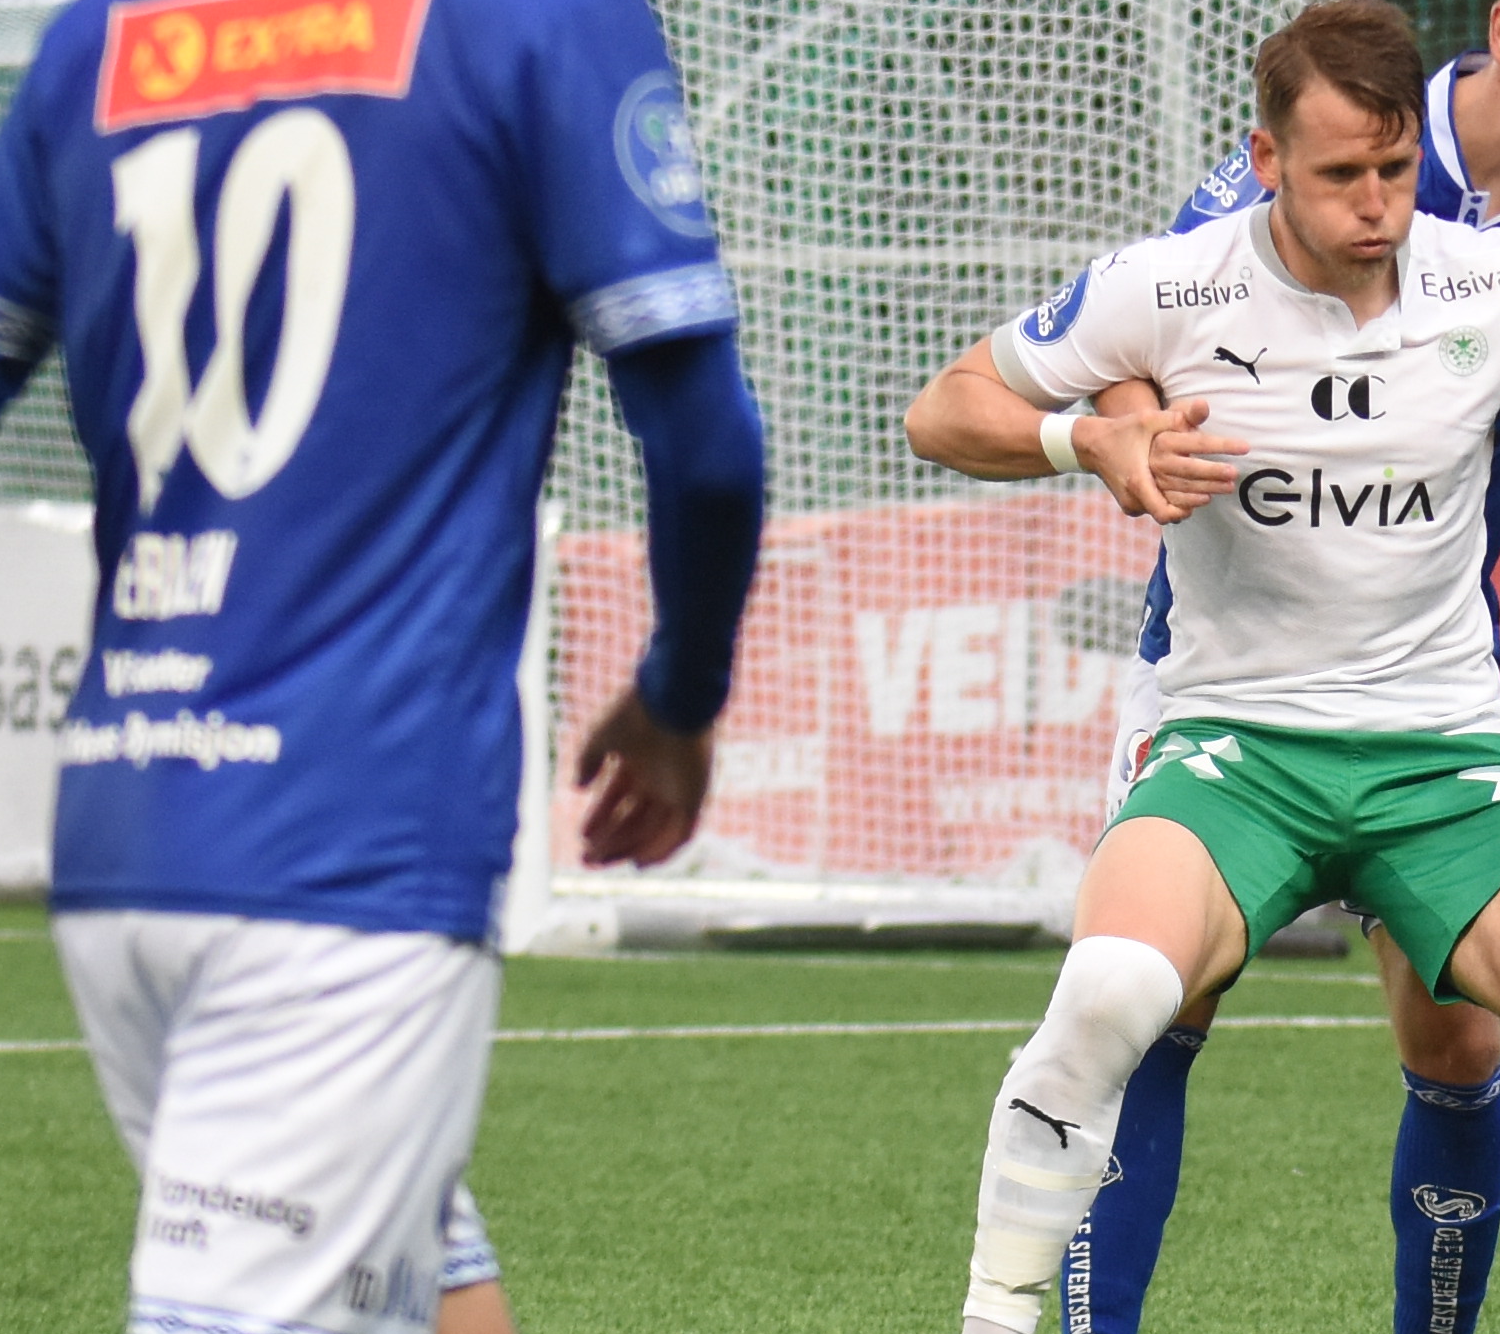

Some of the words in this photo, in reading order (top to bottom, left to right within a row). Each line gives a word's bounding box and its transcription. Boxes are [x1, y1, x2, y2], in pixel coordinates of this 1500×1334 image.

[212, 0, 375, 72] EXTRA
[112, 105, 357, 514] 10
[1155, 278, 1251, 310] Eidsiva
